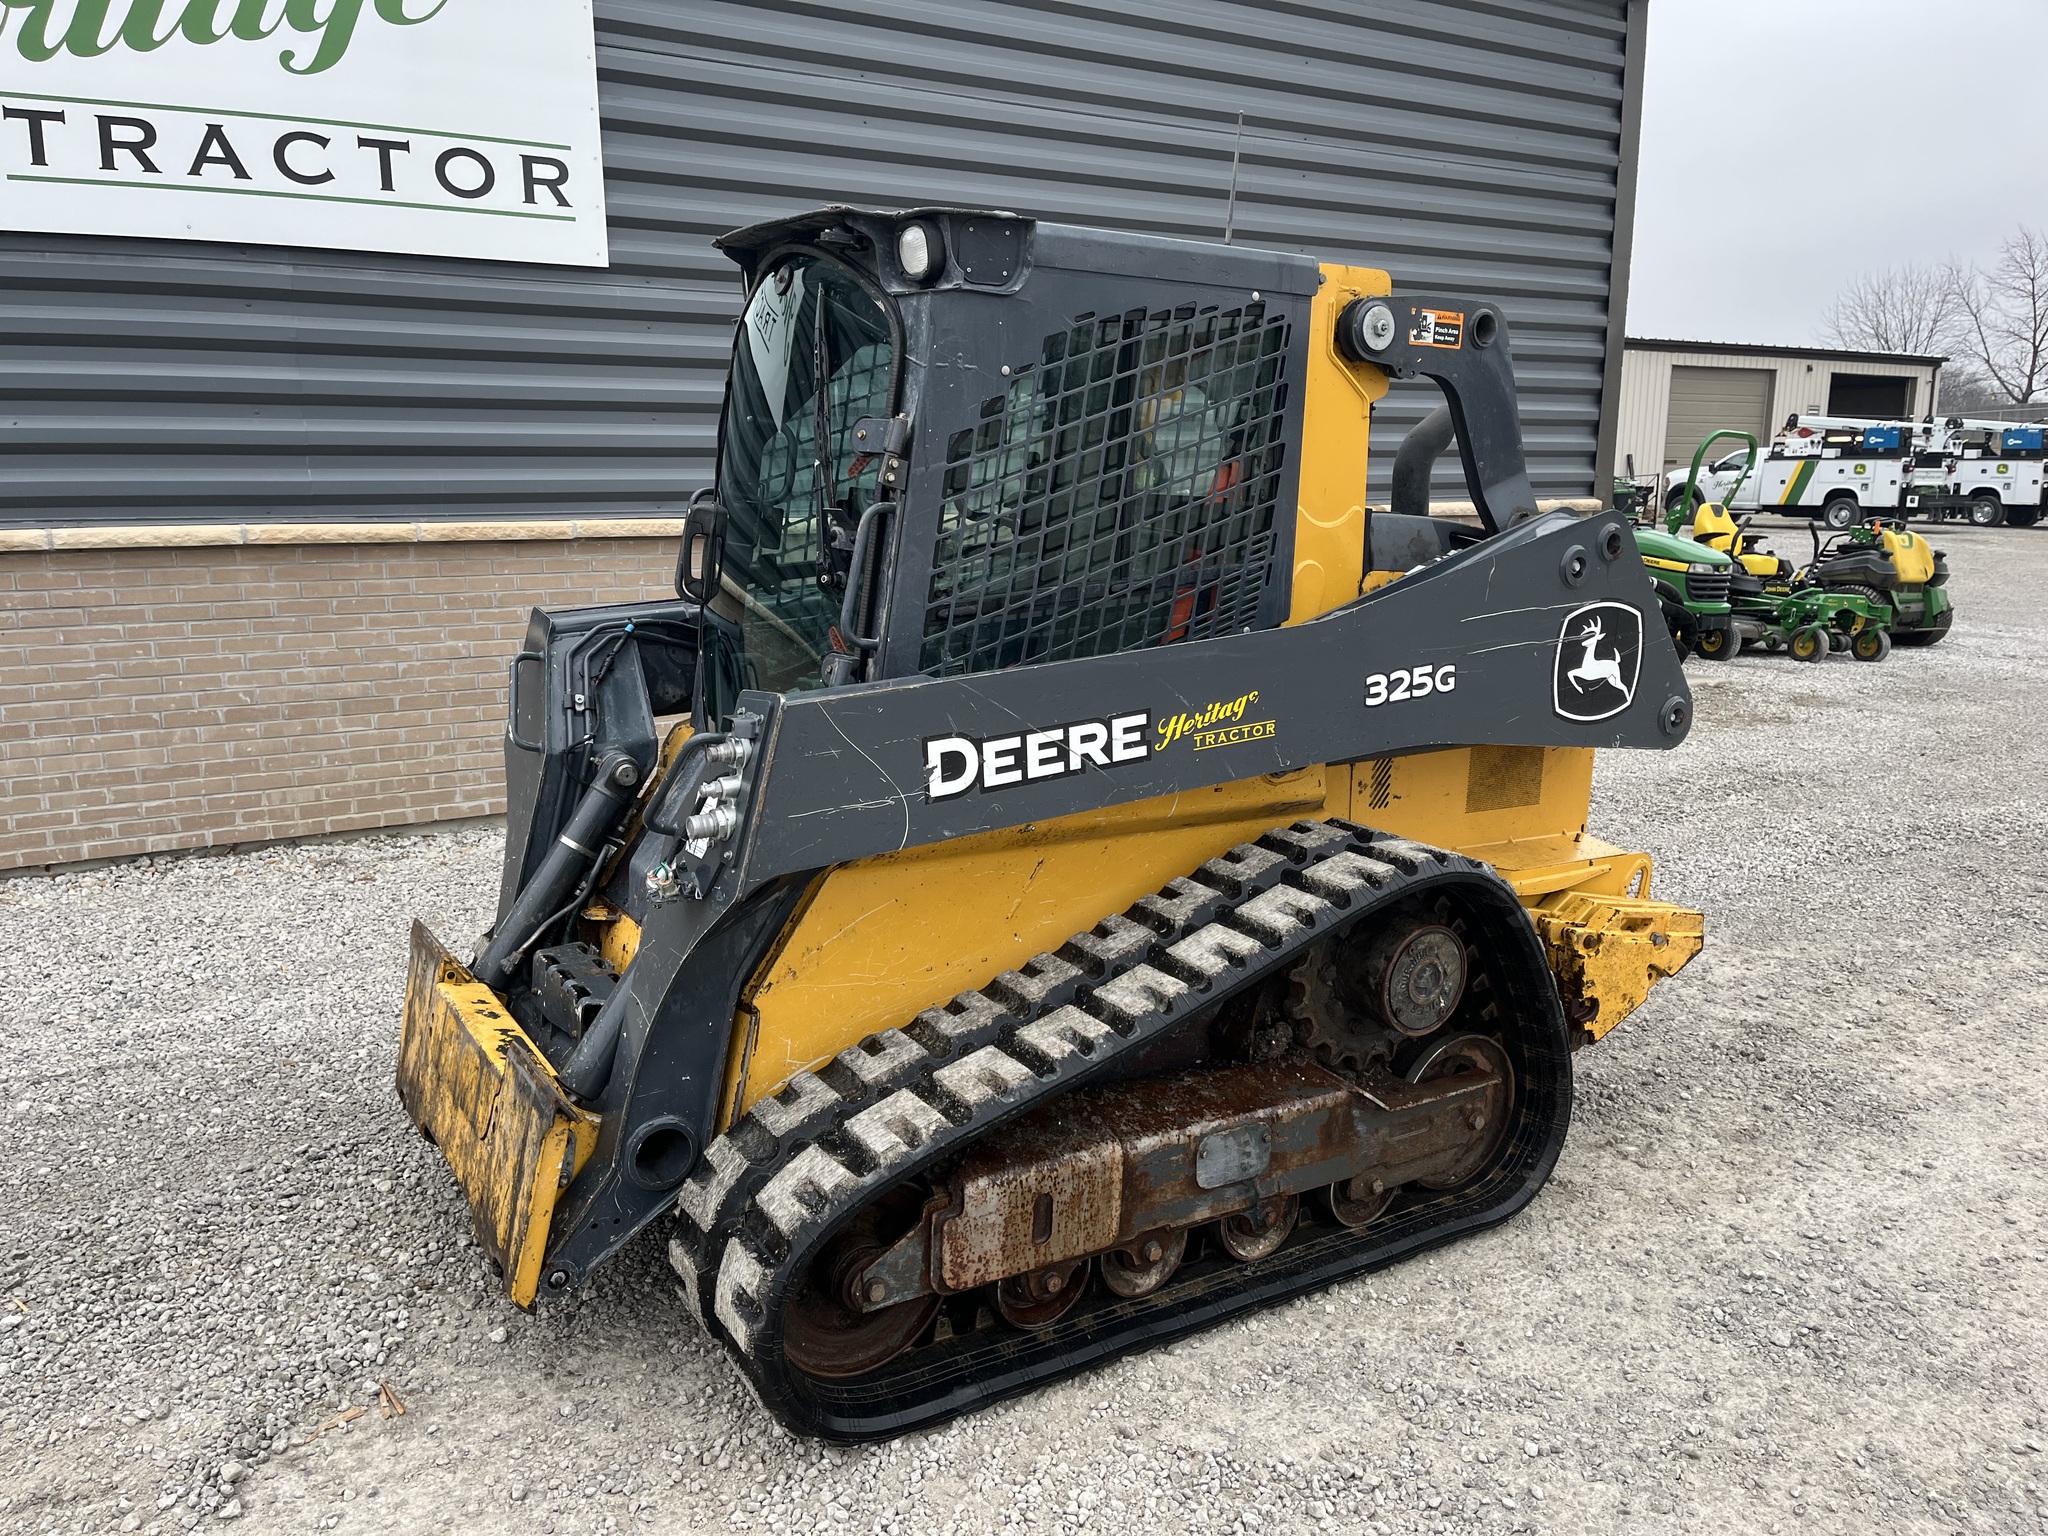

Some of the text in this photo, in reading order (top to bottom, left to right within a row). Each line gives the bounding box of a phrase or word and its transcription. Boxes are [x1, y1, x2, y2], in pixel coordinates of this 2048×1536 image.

[2, 106, 573, 207] TRACTOR
[1435, 326, 1448, 334] Pinch
[1643, 557, 1660, 565] DEERE
[1365, 664, 1456, 706] 325G
[1155, 690, 1260, 751] Heritage
[1194, 723, 1276, 747] TRACTOR
[928, 713, 1148, 799] DEERE
